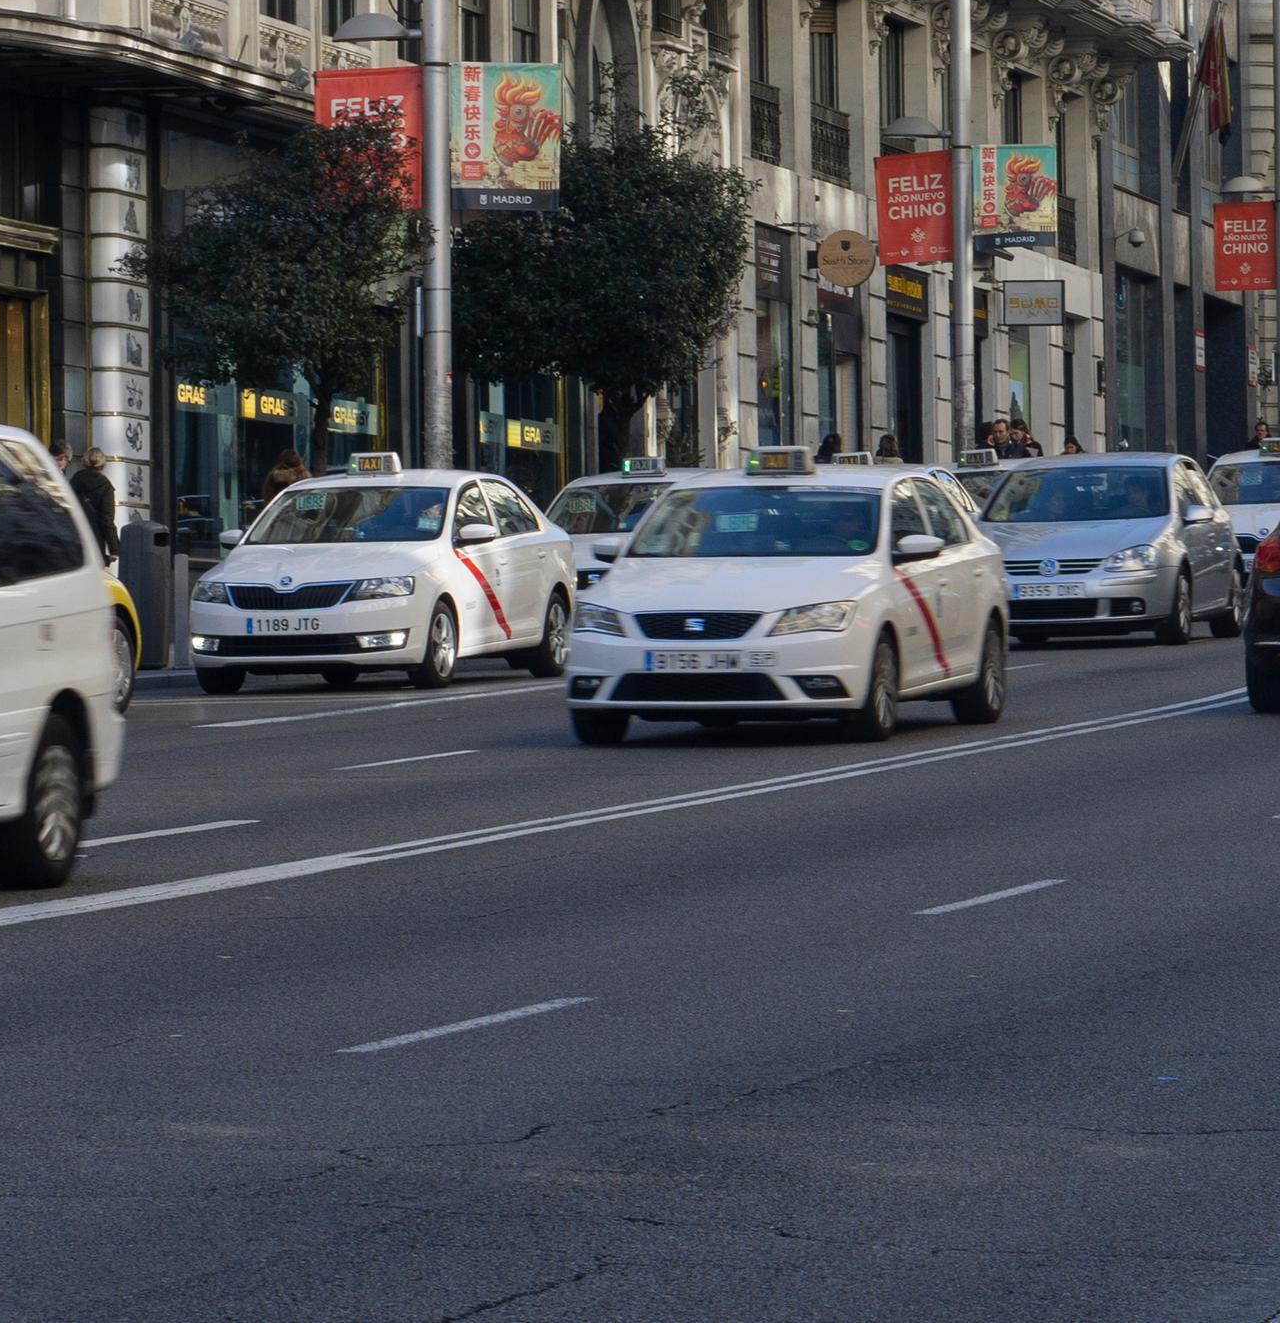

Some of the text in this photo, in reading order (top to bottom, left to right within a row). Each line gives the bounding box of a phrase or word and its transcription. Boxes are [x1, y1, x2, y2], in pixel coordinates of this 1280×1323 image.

[463, 66, 480, 141] 新春快乐
[982, 147, 996, 201] 新春快乐
[888, 174, 943, 194] FELIZ
[492, 195, 533, 205] MADRID
[888, 191, 945, 204] AÑO NUEVO
[888, 202, 946, 220] CHINO
[1223, 219, 1267, 233] FELIZ
[1004, 235, 1036, 244] MADRID
[1240, 233, 1268, 241] NUEVO
[1222, 242, 1269, 255] CHINO
[359, 458, 382, 471] TAXI
[257, 618, 320, 632] 1189 JTG
